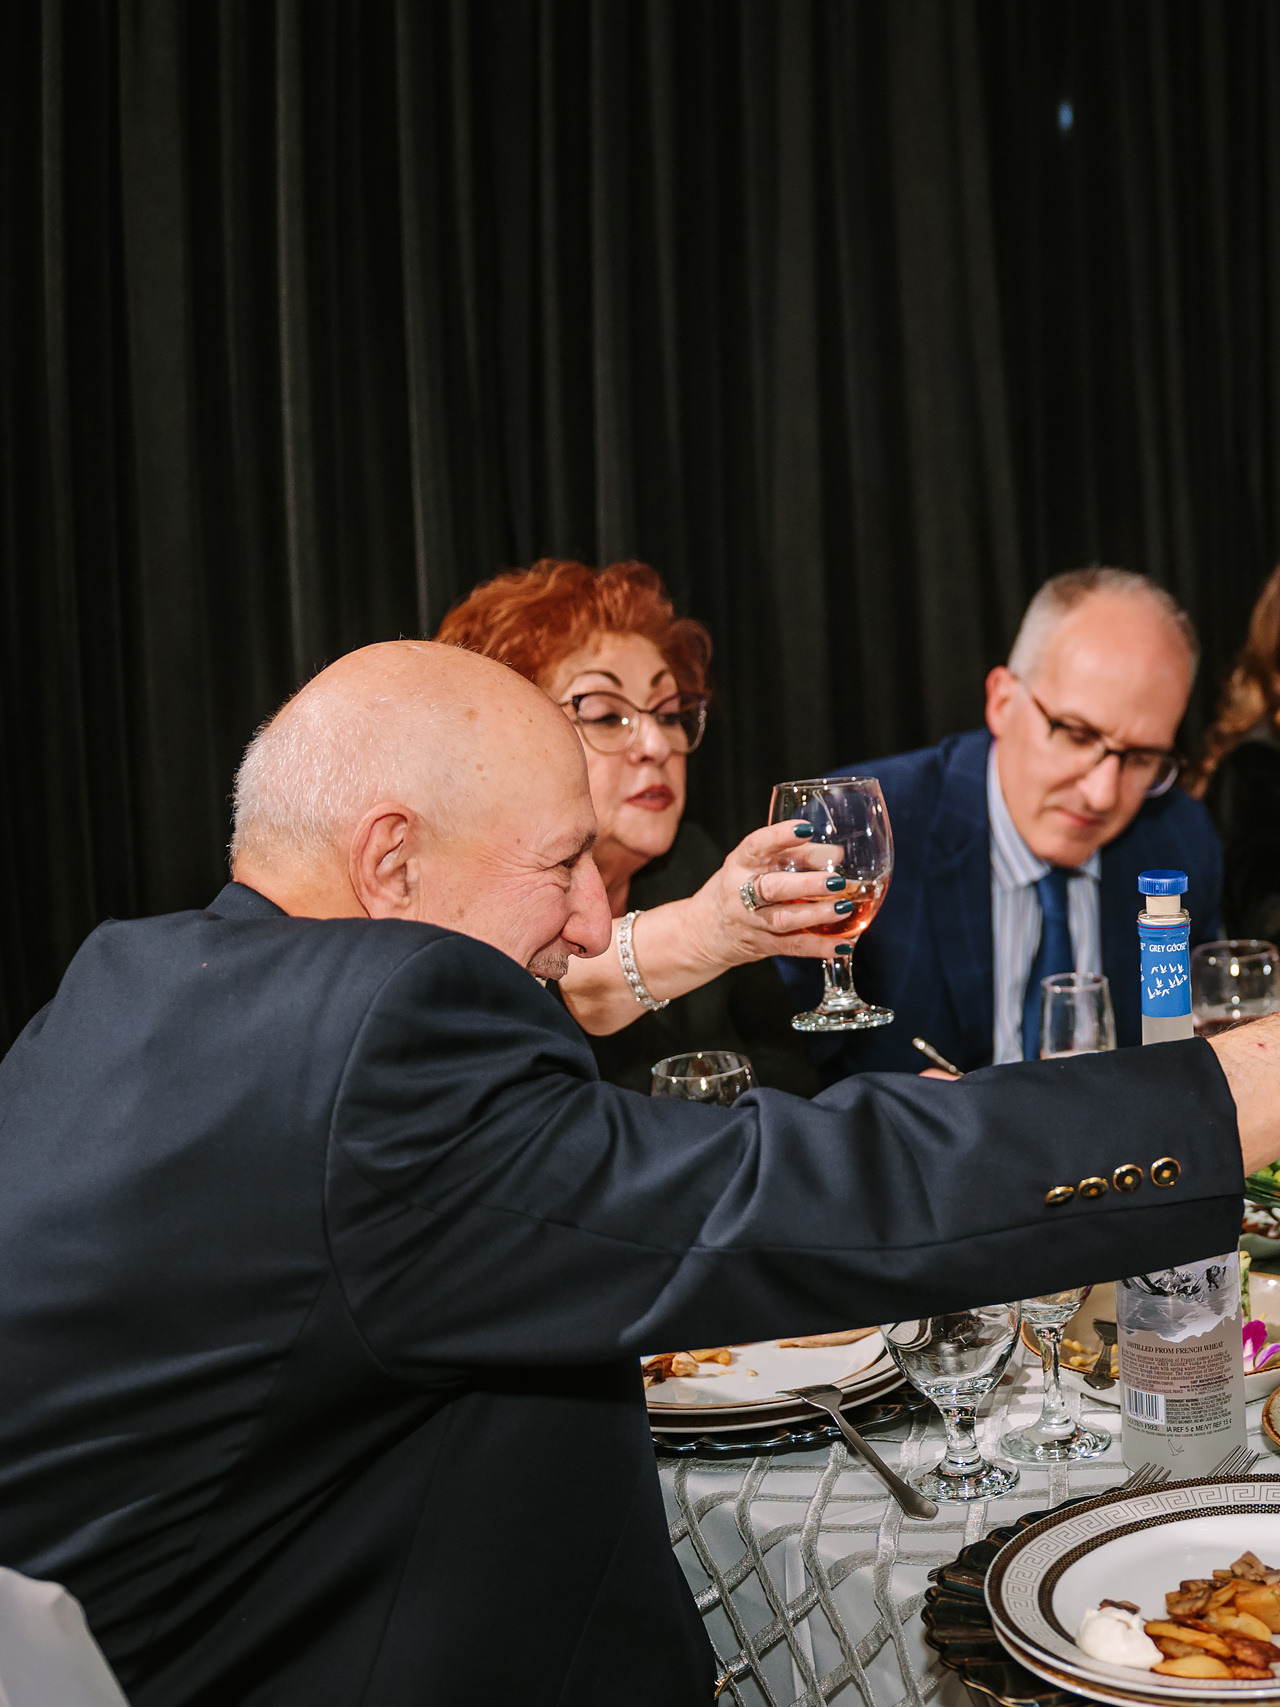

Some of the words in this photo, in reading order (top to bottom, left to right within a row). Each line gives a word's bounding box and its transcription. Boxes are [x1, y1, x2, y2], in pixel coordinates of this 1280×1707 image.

[1149, 944, 1165, 952] GREY
[1127, 1341, 1153, 1352] DISTILLED
[1155, 1346, 1174, 1354] FROM
[1176, 1346, 1203, 1354] FRENCH
[1204, 1341, 1223, 1351] WHEAT
[1145, 1422, 1160, 1431] FREE
[1213, 1420, 1222, 1428] REF
[1222, 1418, 1228, 1426] 15
